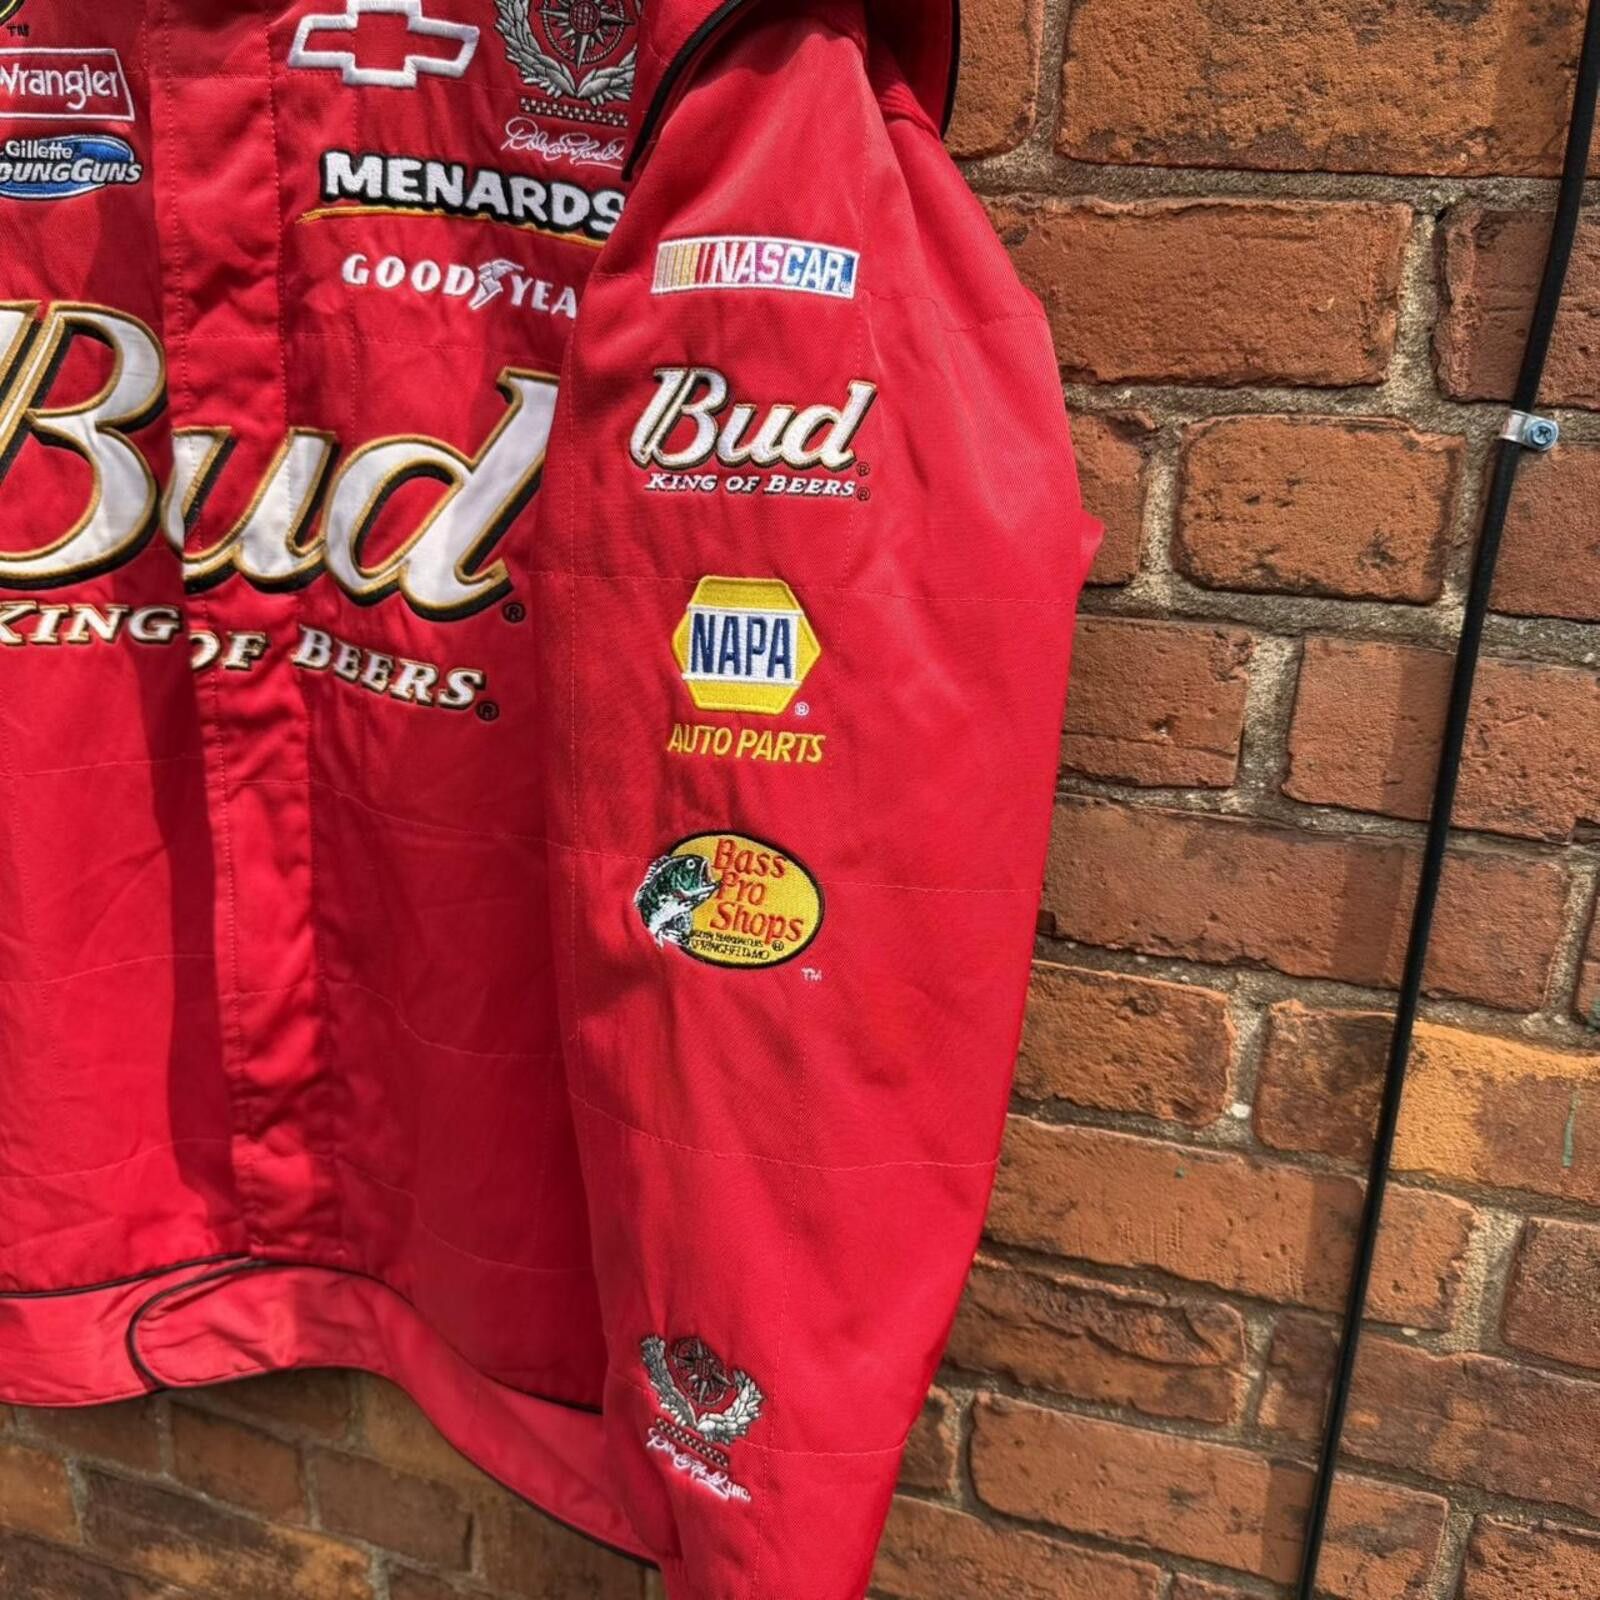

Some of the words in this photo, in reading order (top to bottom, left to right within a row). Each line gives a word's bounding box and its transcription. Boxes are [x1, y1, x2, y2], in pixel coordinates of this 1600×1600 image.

[5, 140, 73, 159] Gillette
[321, 149, 626, 237] MENARDS
[708, 241, 846, 291] NASCAR
[630, 366, 877, 470] Bud
[0, 299, 560, 622] Bud
[646, 472, 717, 491] KING
[725, 475, 760, 492] OF
[764, 475, 855, 496] BEERS
[291, 623, 487, 710] BEERS
[690, 612, 791, 679] NAPA
[667, 723, 733, 756] AUTO
[735, 729, 826, 763] PARTS
[712, 838, 787, 878] Bass
[715, 869, 767, 906] Pro
[709, 901, 804, 945] Shops
